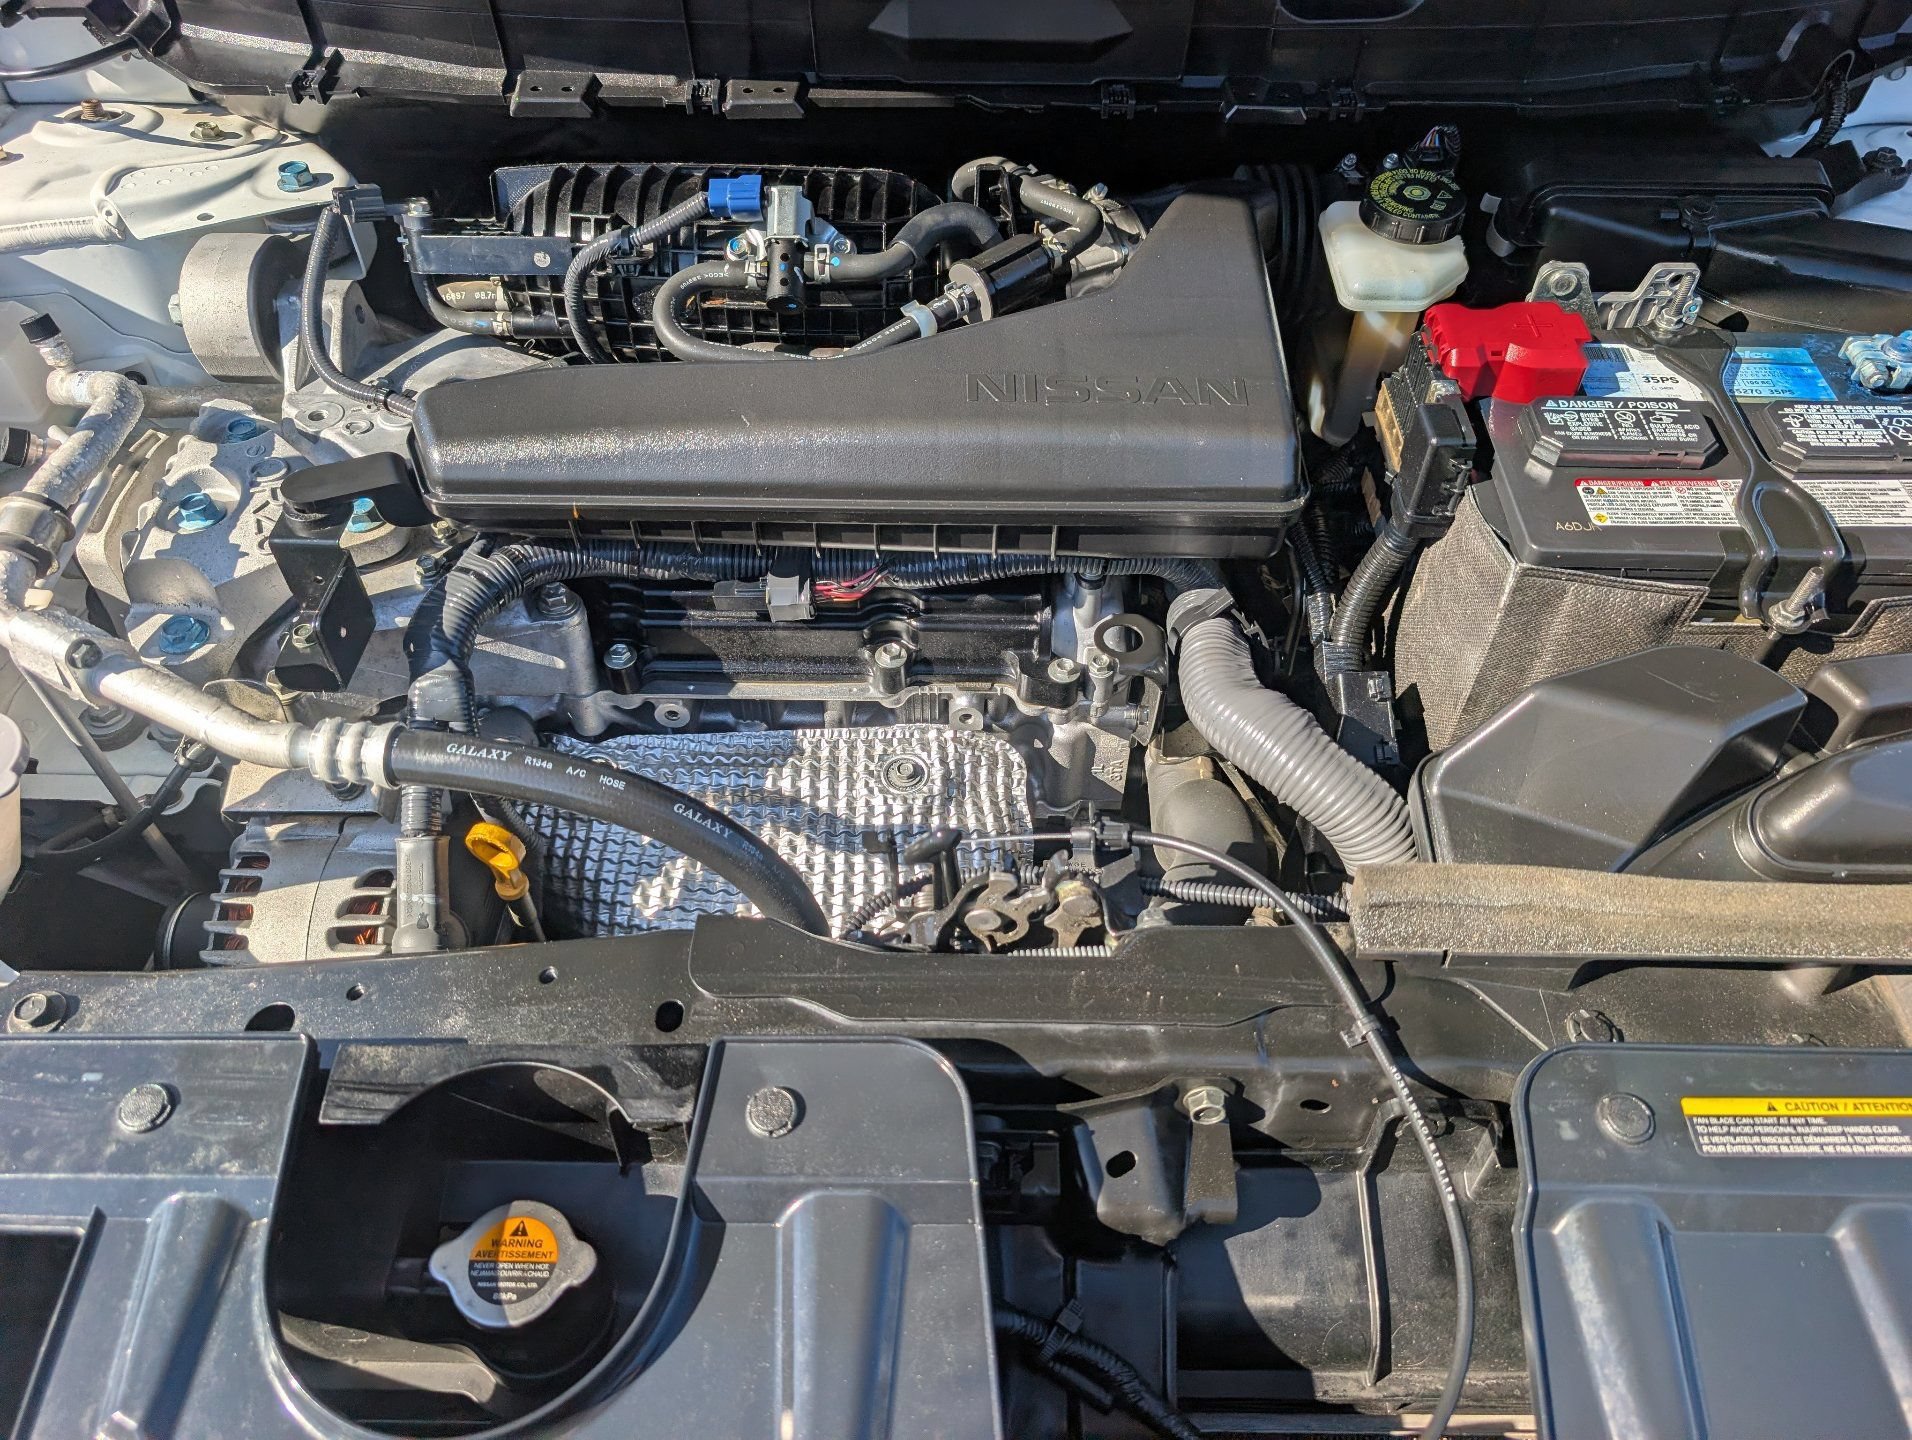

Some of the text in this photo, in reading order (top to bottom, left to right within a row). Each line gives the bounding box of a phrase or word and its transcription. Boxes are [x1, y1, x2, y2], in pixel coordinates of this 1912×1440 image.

[1642, 376, 1680, 384] 35PS
[966, 374, 1249, 406] NISSAN
[1558, 400, 1614, 408] DANGER
[1628, 401, 1678, 410] POISON
[446, 742, 626, 792] GALAXY R134a A/C HOSE
[673, 802, 734, 839] GALAXY
[1784, 1102, 1839, 1112] CAUTION
[491, 1239, 543, 1248] WARNING
[475, 1250, 554, 1258] AVERTISSEMENT
